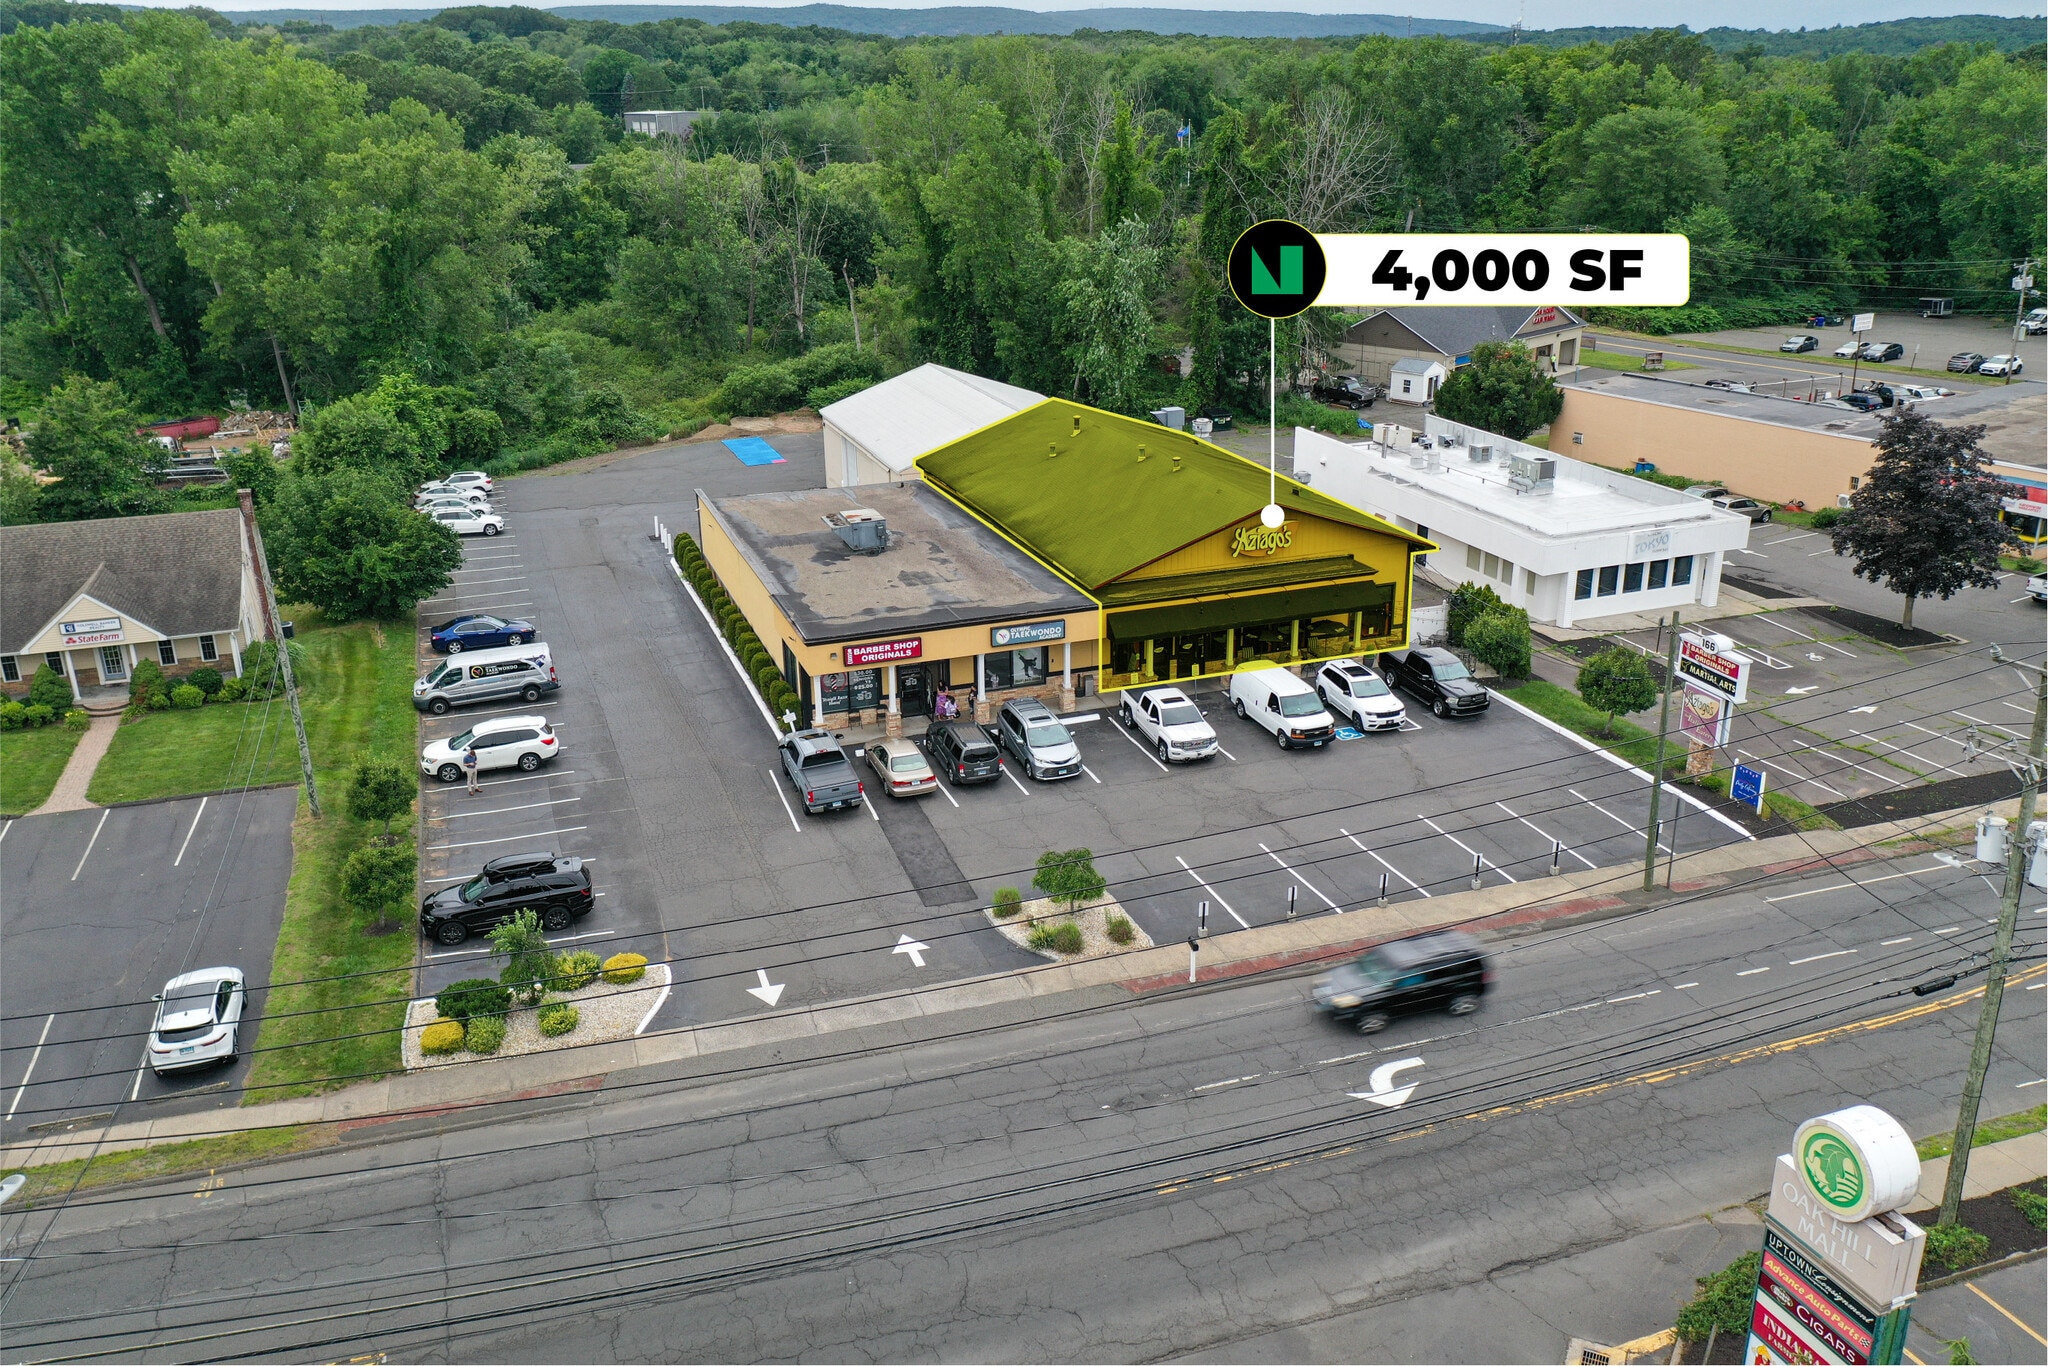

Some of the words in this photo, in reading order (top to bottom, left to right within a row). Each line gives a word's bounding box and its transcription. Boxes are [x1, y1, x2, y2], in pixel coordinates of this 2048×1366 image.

[1231, 525, 1292, 557] Aziago's
[1635, 533, 1669, 555] TOKYO
[1010, 626, 1062, 639] TAEKWONDO
[1702, 638, 1716, 652] 166
[853, 644, 891, 656] BARBER
[893, 640, 919, 651] SHOP
[861, 649, 912, 662] ORIGINALS
[1690, 645, 1717, 662] BARBER
[1717, 657, 1737, 670] SHOP
[1694, 654, 1730, 675] ORIGINALS
[1689, 665, 1718, 685] MARTIAL
[1719, 679, 1736, 693] ARTS
[1782, 1182, 1825, 1228] OAK
[1797, 1216, 1854, 1273] MALL
[1768, 1233, 1813, 1277] UPTOWN
[1811, 1268, 1874, 1324] Consignment
[1764, 1259, 1805, 1295] Advance
[1805, 1293, 1832, 1316] Auto
[1830, 1314, 1862, 1341] Parts
[1762, 1313, 1799, 1354] INDIA
[1796, 1304, 1856, 1363] CIGARS
